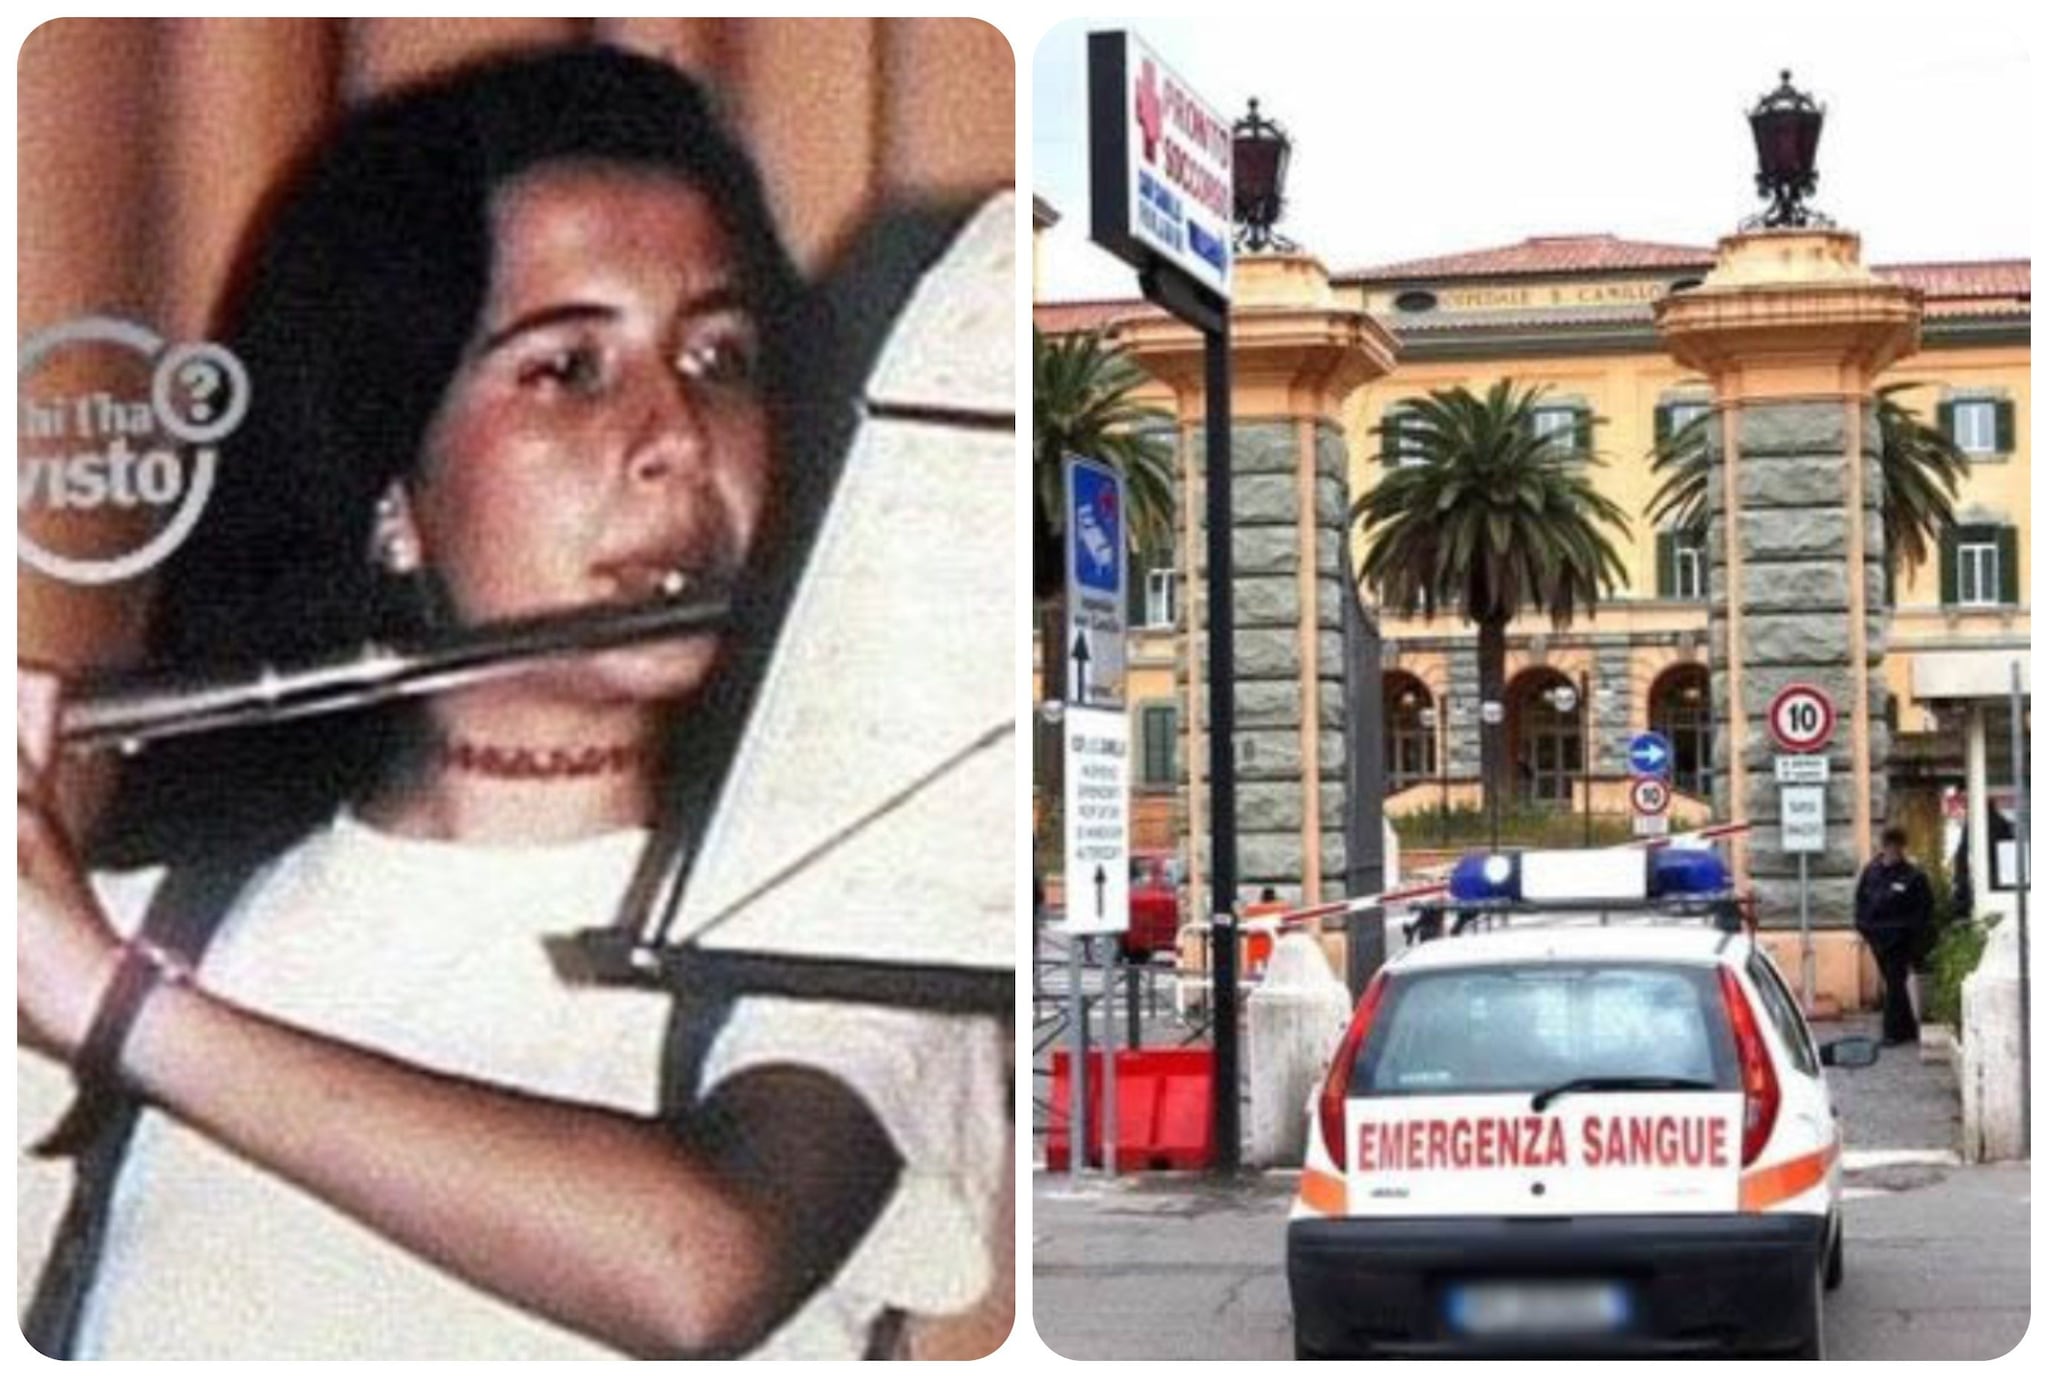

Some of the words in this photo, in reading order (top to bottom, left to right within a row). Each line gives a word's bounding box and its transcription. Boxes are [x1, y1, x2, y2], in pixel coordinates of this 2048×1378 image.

[1163, 78, 1229, 170] PRONTO
[1788, 703, 1817, 732] 10
[1358, 1116, 1567, 1171] EMERGENZA
[1582, 1115, 1728, 1168] SANGUE
